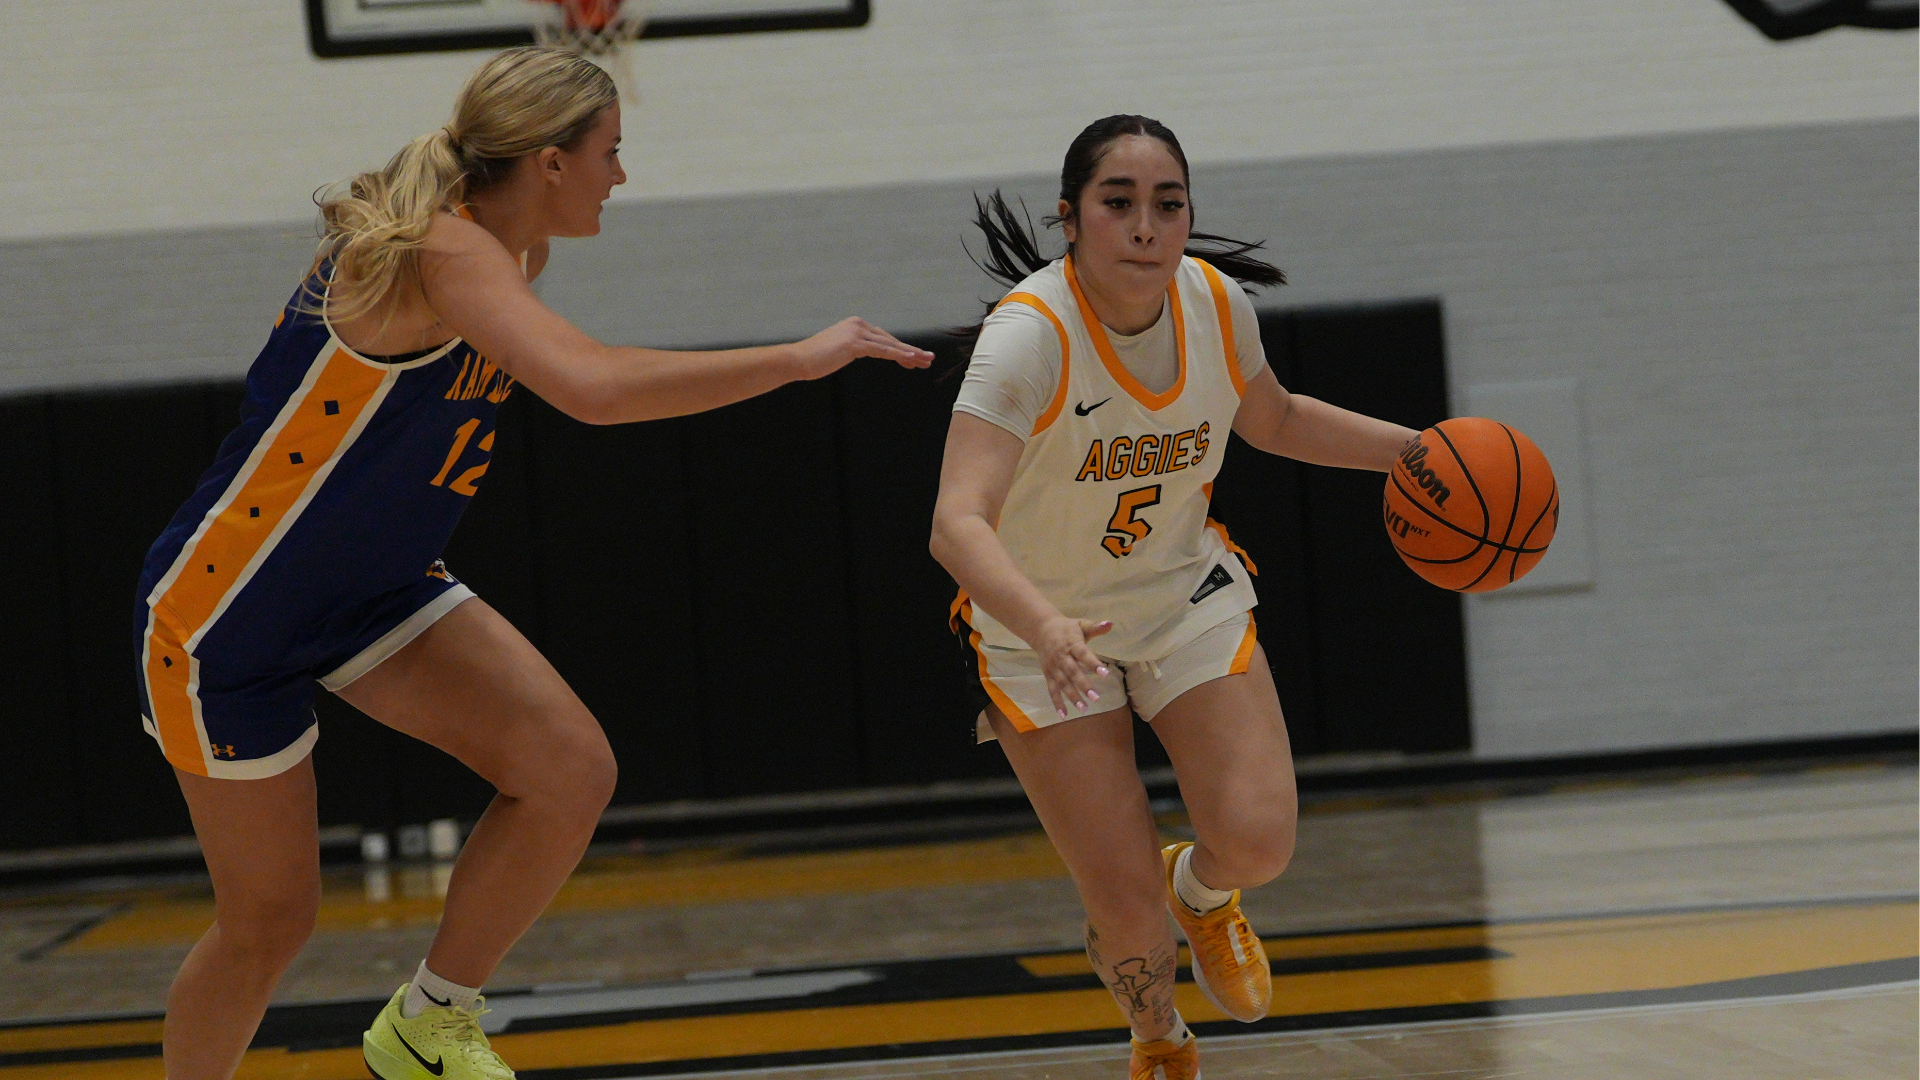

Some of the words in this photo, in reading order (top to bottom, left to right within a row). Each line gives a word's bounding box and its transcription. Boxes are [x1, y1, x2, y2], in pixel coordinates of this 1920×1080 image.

[429, 417, 496, 497] 12
[1075, 421, 1210, 481] AGGIES
[1100, 484, 1162, 558] 5
[1384, 500, 1411, 539] VO
[1410, 525, 1432, 537] NXT
